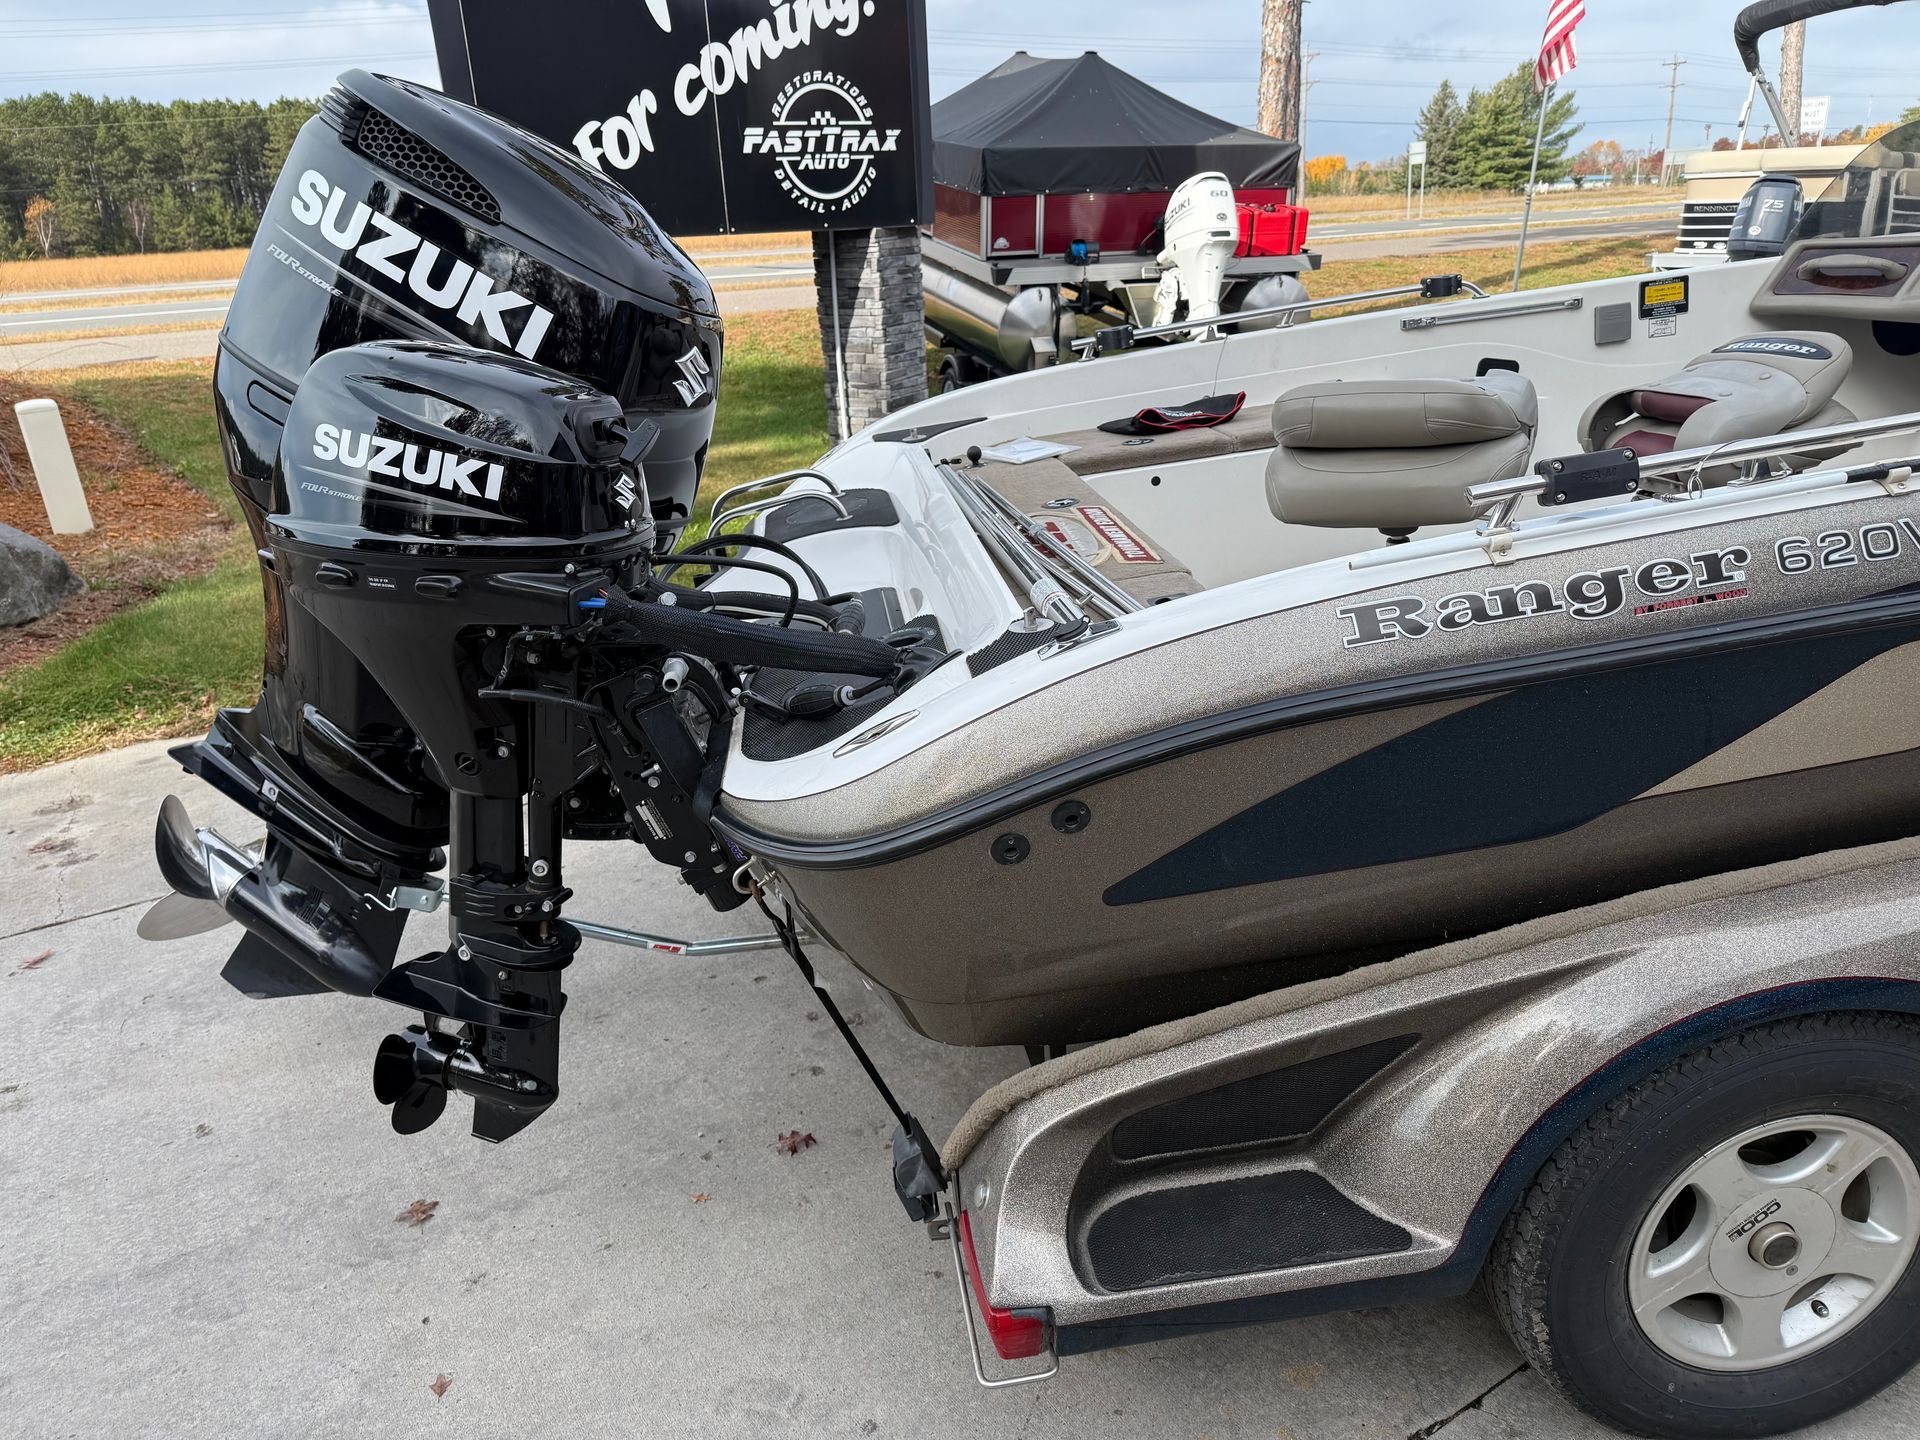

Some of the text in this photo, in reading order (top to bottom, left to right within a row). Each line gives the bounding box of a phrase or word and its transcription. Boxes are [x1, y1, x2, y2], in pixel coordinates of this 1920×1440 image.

[572, 0, 875, 172] For coming
[771, 70, 874, 118] RESTORATIONS
[742, 127, 902, 154] FASTTRAX
[798, 153, 850, 170] AUTO
[774, 166, 877, 214] DETAIL AUDIO
[1763, 199, 1784, 208] 75
[290, 169, 554, 361] SUZUKI
[312, 423, 504, 502] SUZUKI
[1336, 546, 1751, 648] Ranger
[1636, 605, 1649, 615] BY
[1715, 589, 1747, 600] WOOD
